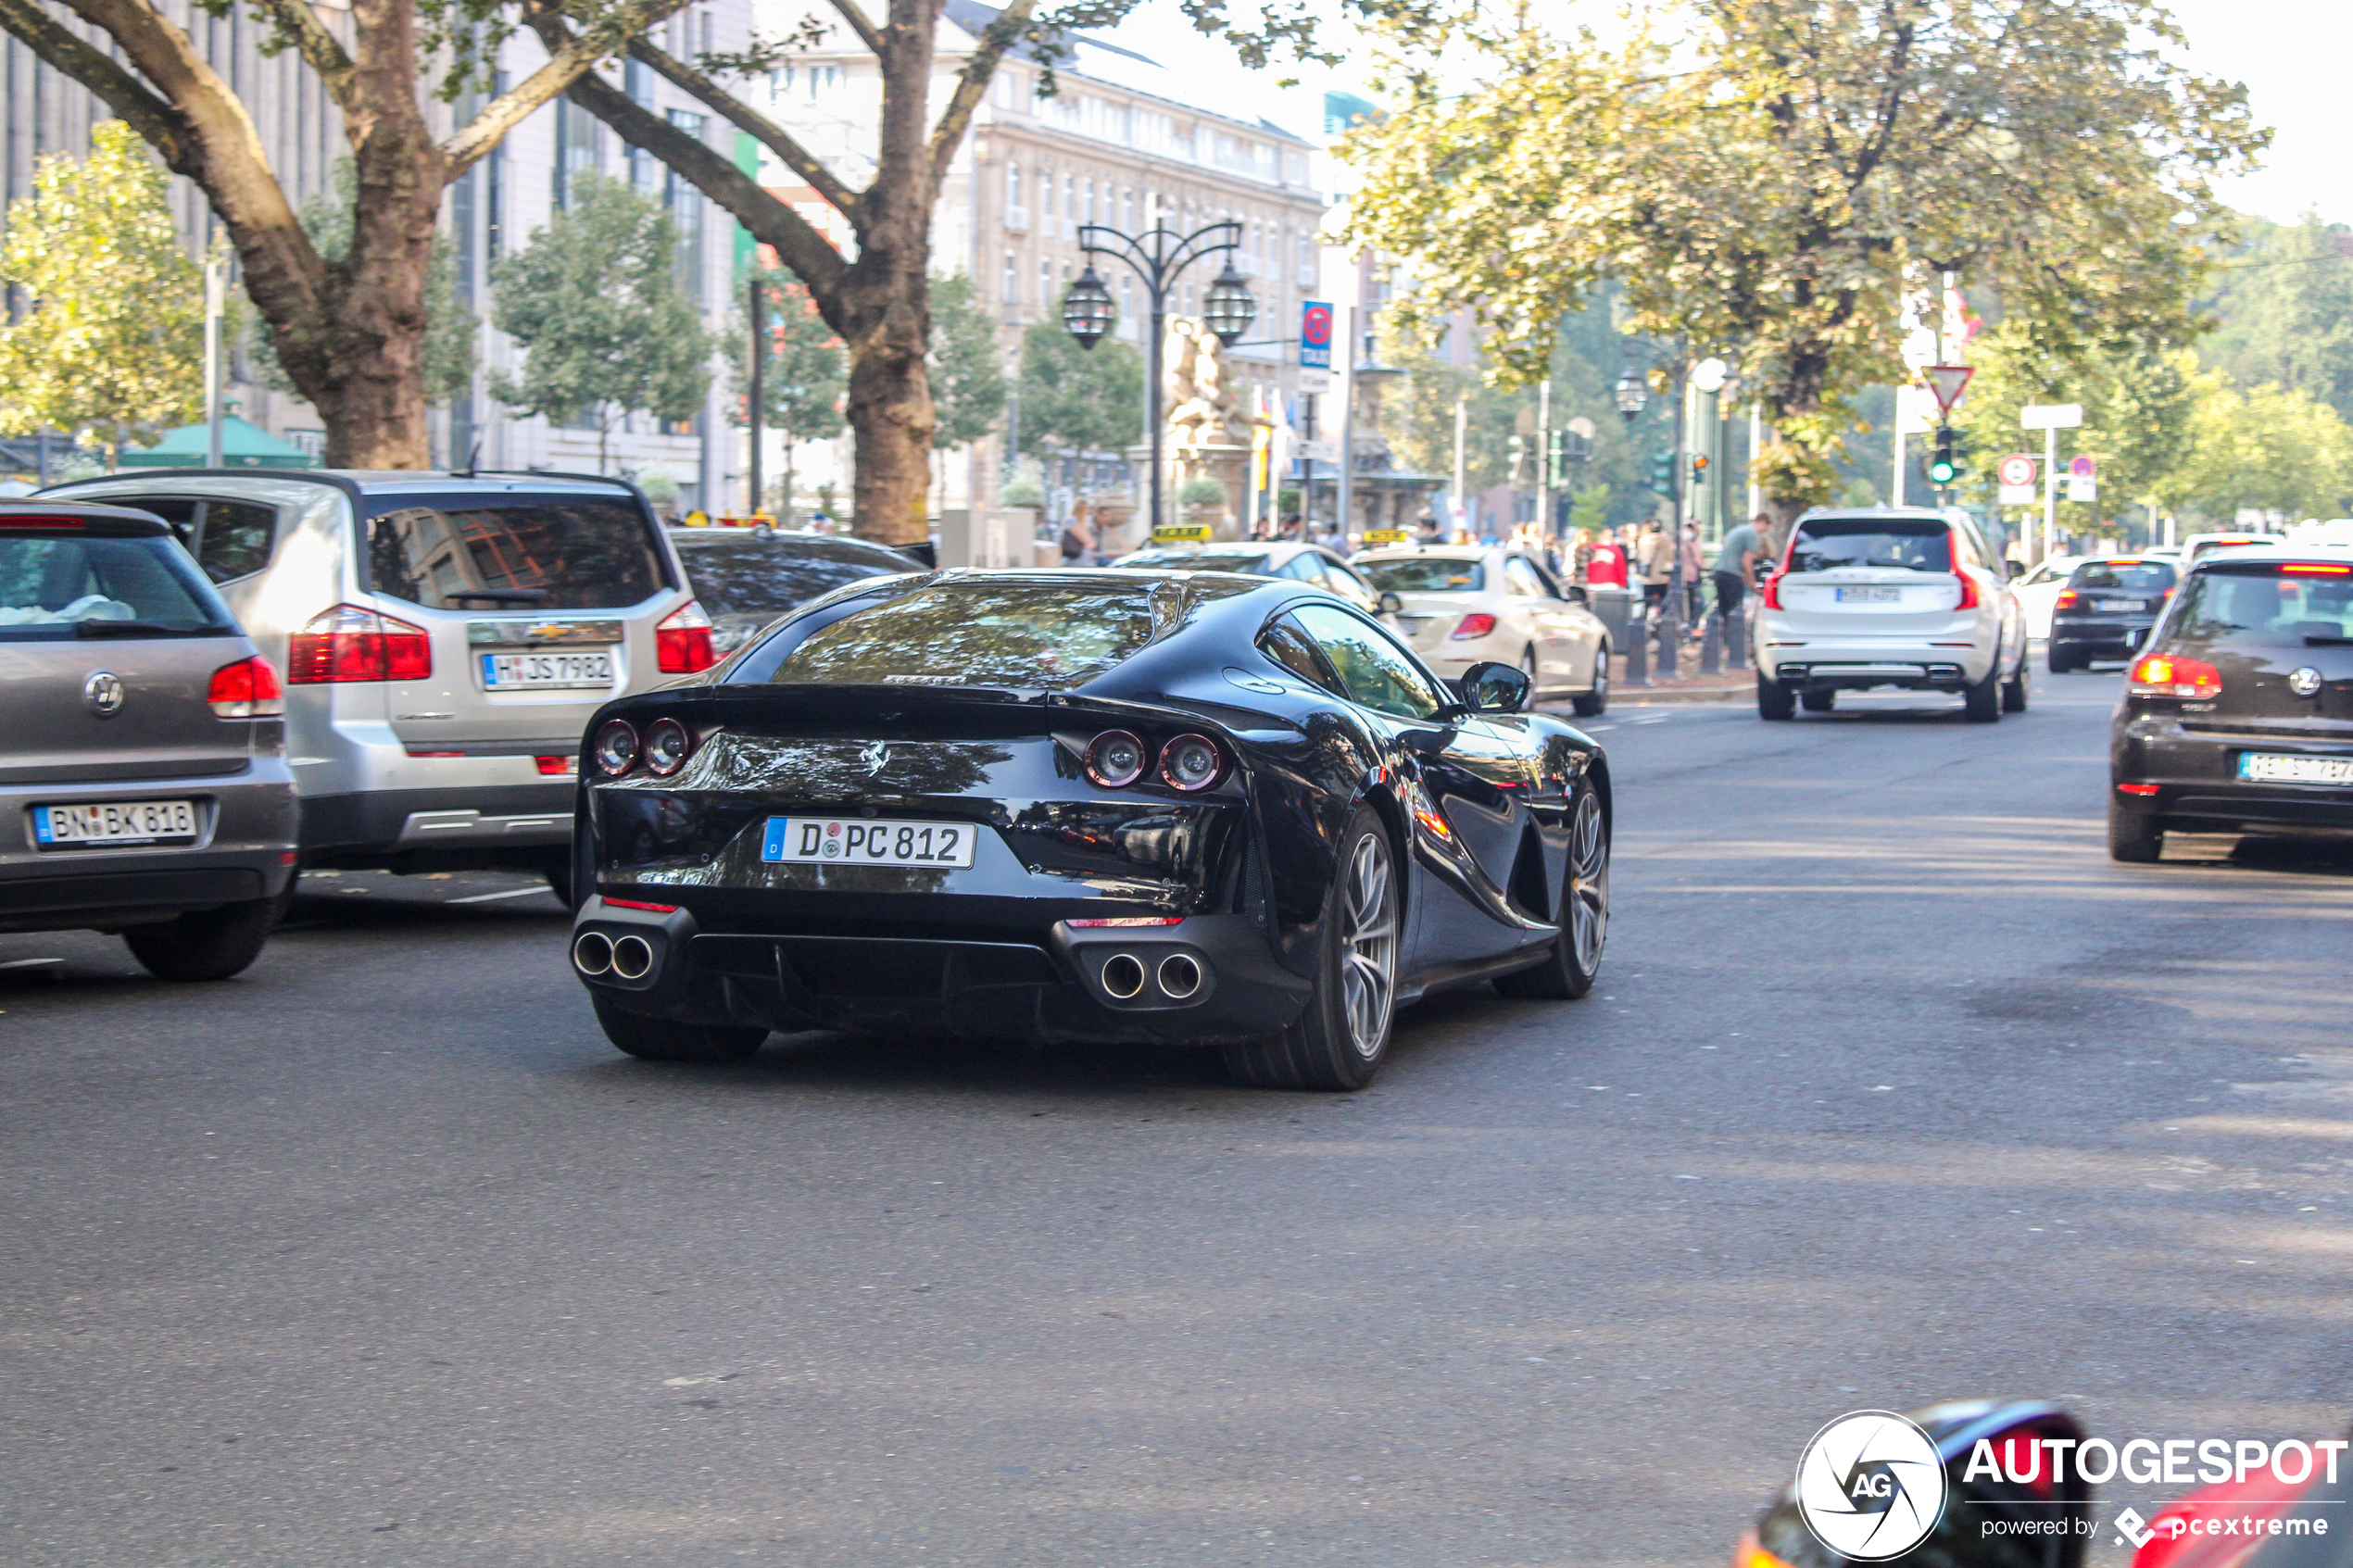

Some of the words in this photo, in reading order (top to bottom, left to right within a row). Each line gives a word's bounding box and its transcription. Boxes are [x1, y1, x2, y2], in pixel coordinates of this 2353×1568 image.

[1154, 527, 1202, 537] TAXI
[497, 657, 513, 682] H
[558, 656, 610, 679] 7982
[54, 808, 87, 837] BN
[106, 807, 138, 834] BK
[145, 805, 189, 832] 818
[769, 844, 778, 854] D
[799, 823, 822, 856] D
[845, 825, 887, 858] PC
[894, 826, 960, 860] 812
